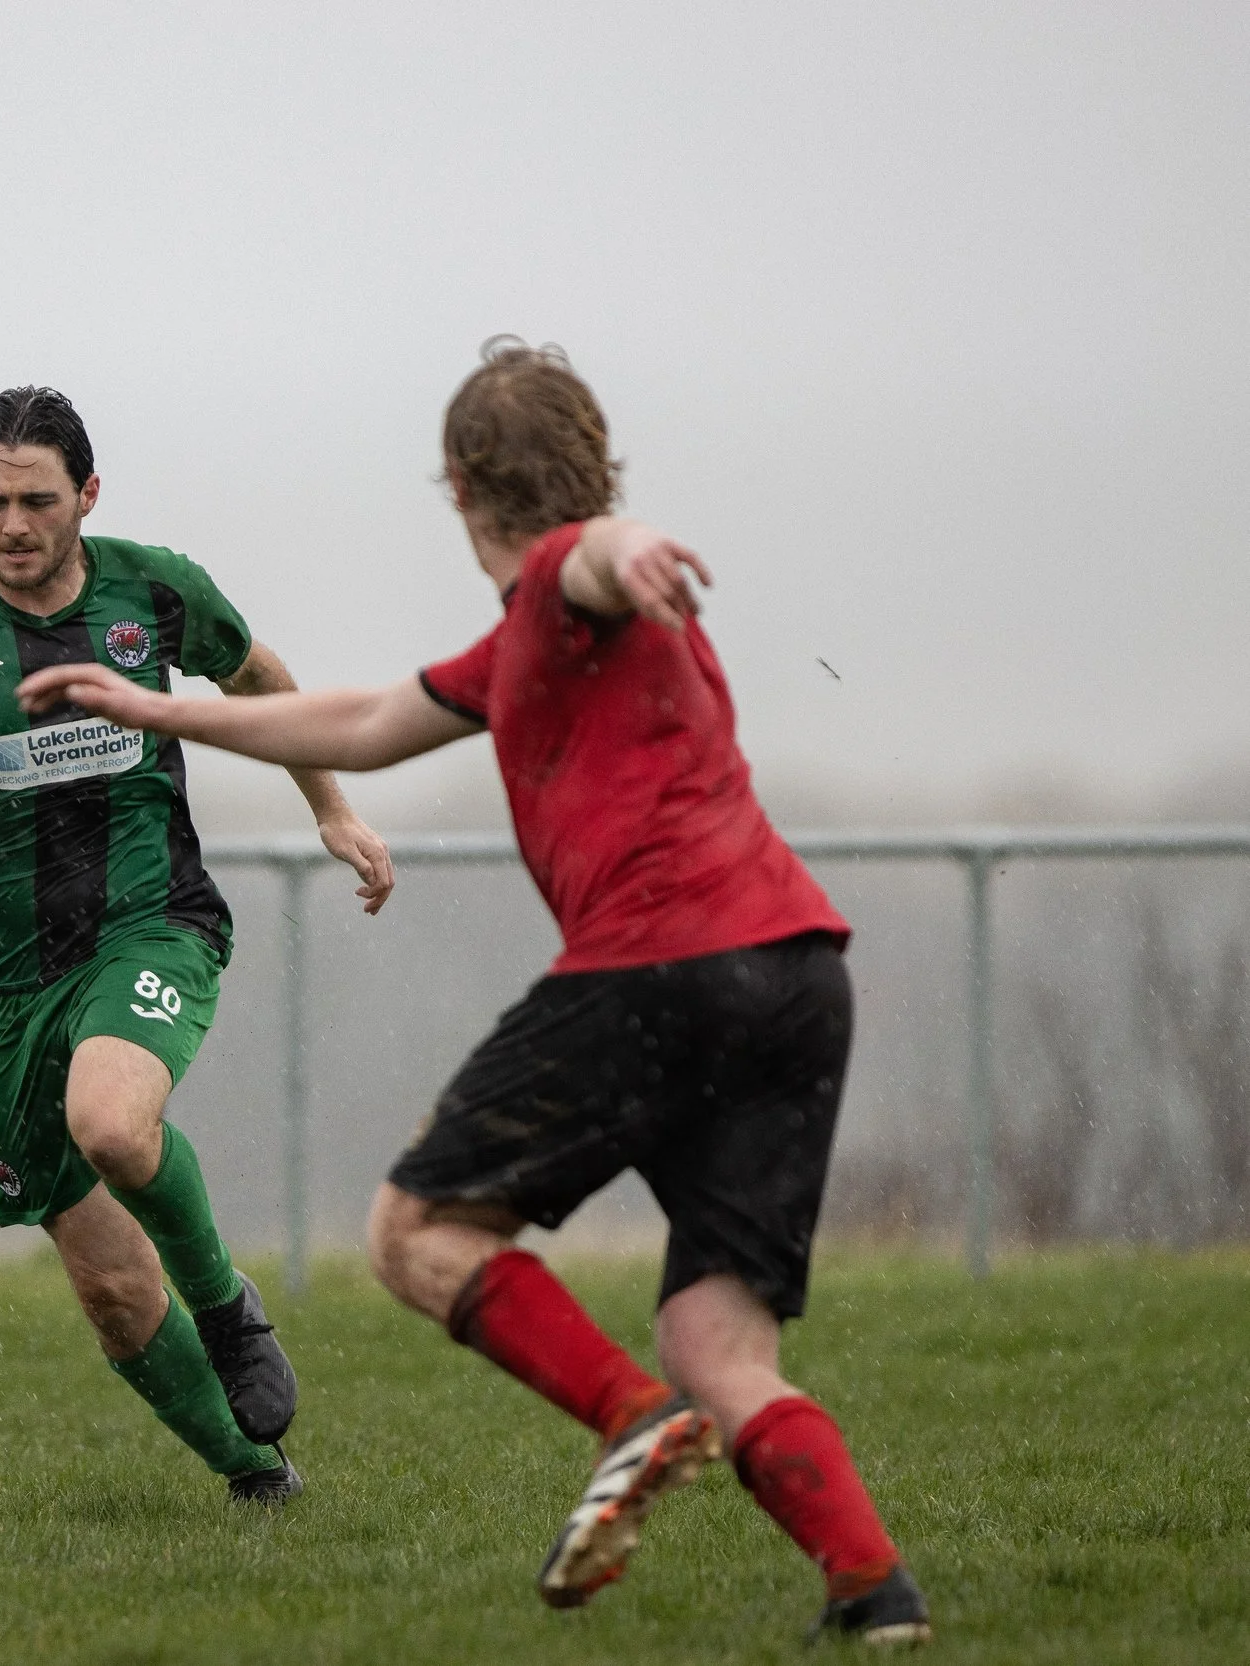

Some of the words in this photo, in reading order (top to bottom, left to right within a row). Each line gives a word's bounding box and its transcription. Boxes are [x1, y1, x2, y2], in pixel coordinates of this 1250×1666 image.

[30, 733, 141, 767] Verandahs
[45, 763, 90, 778] FENCING
[97, 749, 141, 769] PERGOLAS
[134, 970, 181, 1016] 80
